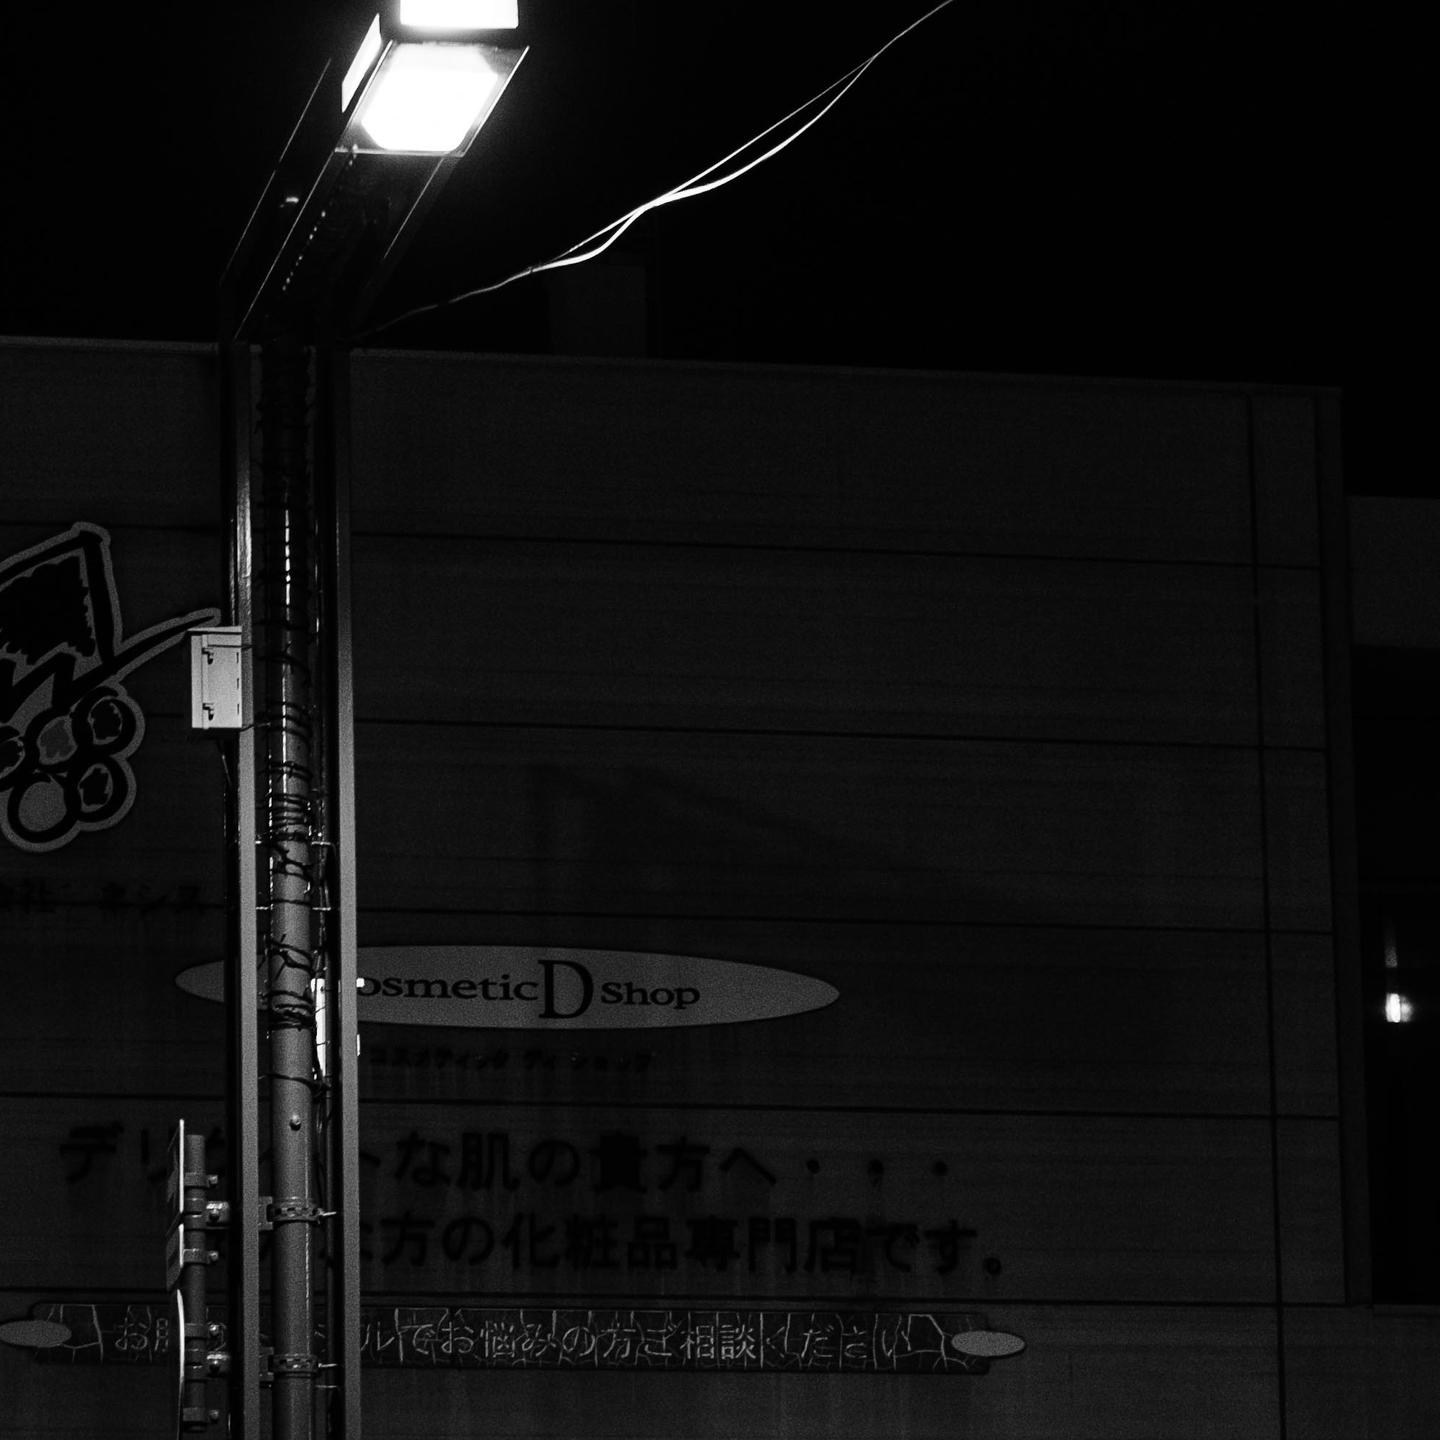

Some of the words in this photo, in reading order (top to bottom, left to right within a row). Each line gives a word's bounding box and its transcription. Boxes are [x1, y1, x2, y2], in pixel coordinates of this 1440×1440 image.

[358, 971, 538, 1001] osmetic
[539, 959, 593, 1018] D
[601, 981, 700, 1009] Shop
